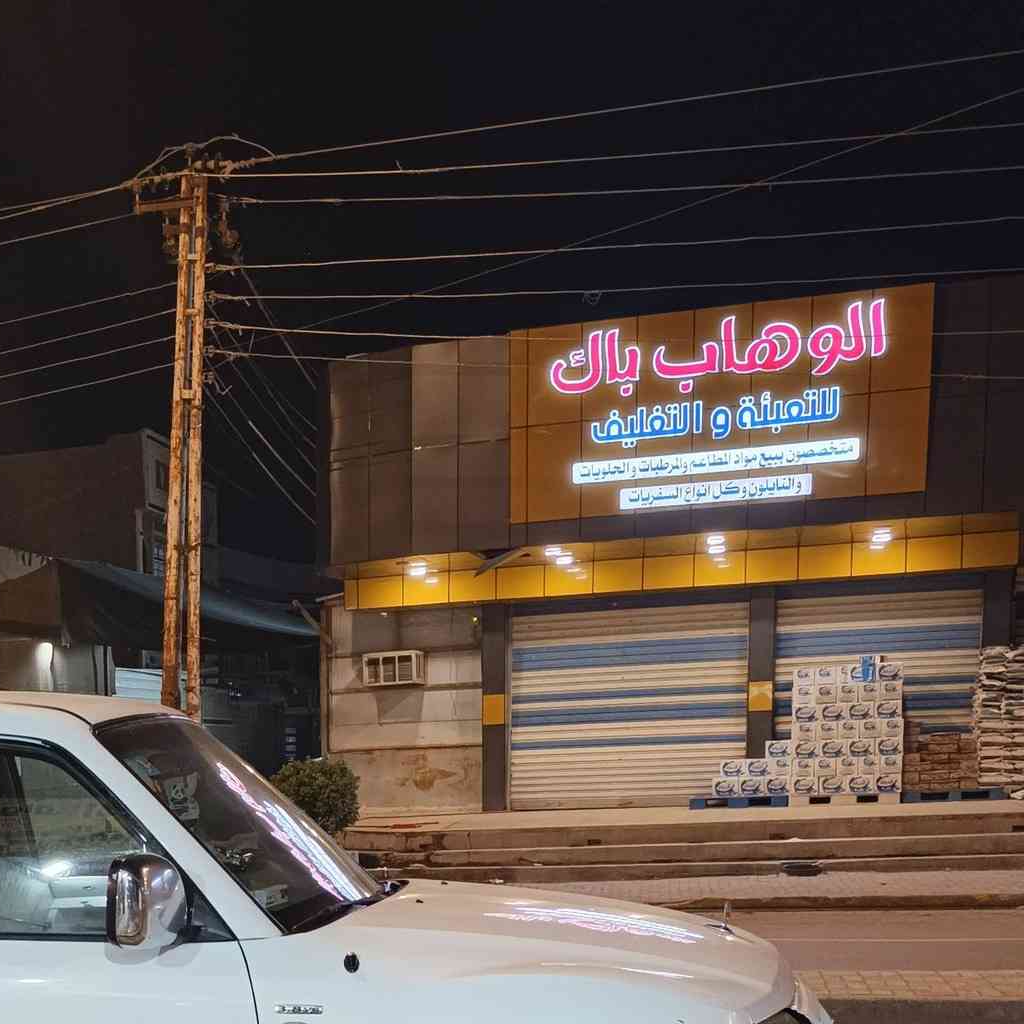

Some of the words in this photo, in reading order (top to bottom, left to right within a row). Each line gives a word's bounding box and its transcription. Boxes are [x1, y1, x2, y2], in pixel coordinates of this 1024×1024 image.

[653, 298, 886, 393] الوهاب
[550, 328, 641, 397] باك
[737, 386, 840, 433] للتعبئة
[591, 400, 703, 448] التغليف
[711, 407, 732, 440] و
[690, 452, 731, 473] المطاعم
[734, 452, 757, 467] مواد
[758, 452, 784, 467] ببيع
[786, 441, 853, 463] متخصصون
[628, 486, 682, 505] السفريات
